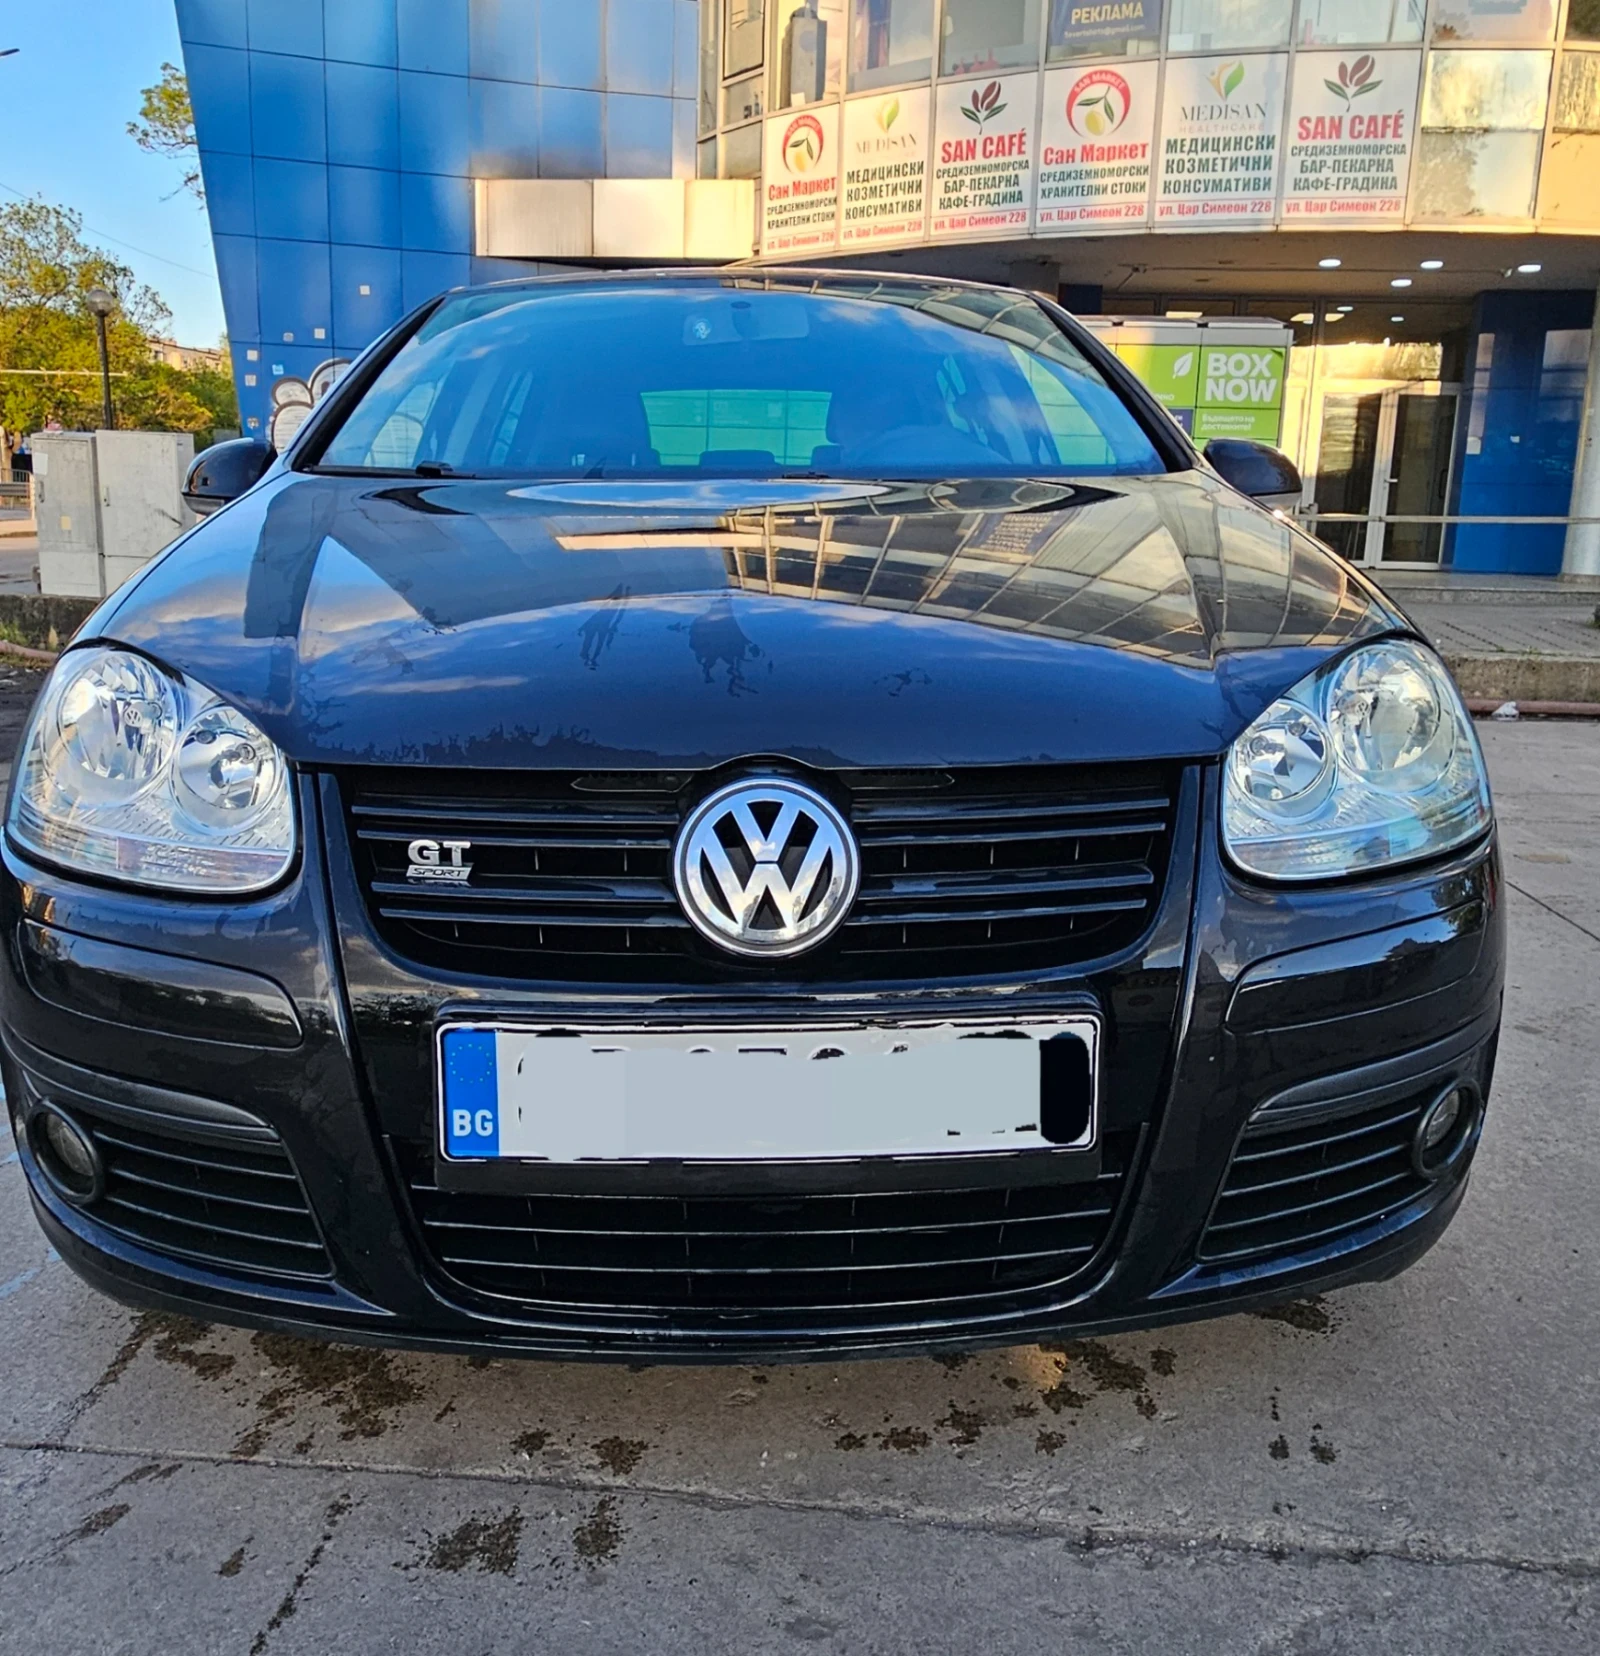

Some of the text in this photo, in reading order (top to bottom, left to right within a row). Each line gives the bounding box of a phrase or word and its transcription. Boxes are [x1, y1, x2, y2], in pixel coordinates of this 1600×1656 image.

[1071, 2, 1144, 25] РЕКЛАМА
[1181, 103, 1268, 120] MEDISAN
[1298, 109, 1404, 140] SAN CAFÉ
[942, 139, 977, 164] SAN
[982, 128, 1026, 159] CAFÉ
[1044, 143, 1148, 166] Сан Маркет
[1166, 135, 1276, 156] МЕДИЦИНСКИ
[1291, 144, 1406, 158] СРЕДИЗЕМНОМОРСКА
[846, 161, 924, 184] МЕДИЦИНСКИ
[936, 159, 1029, 179] СРЕДИЗЕМНОМОРСКА
[1040, 165, 1149, 183] СРЕДИЗЕМНОМОРСКИ
[1165, 155, 1272, 174] КОЗМЕТИЧНИ
[1300, 158, 1394, 174] БАР-ПЕКАРНА
[769, 177, 836, 201] Сан Маркет
[846, 179, 922, 202] КОЗМЕТИЧНИ
[944, 174, 1019, 194] БАР-ПЕКАРНА
[1041, 181, 1146, 199] ХРАНИТЕЛНИ СТОКИ
[1163, 177, 1272, 194] КОНСУМАТИВИ
[1293, 176, 1397, 192] КАФЕ-ГРАДИНА
[845, 199, 922, 220] КОНСУМАТИВИ
[939, 190, 1022, 210] КАФЕ-ГРАДИНА
[1178, 204, 1199, 215] Цар
[1202, 202, 1247, 213] Симеон
[1251, 201, 1271, 213] 228
[1305, 201, 1327, 212] Цар
[1330, 200, 1376, 212] Симеон
[1380, 200, 1400, 212] 228
[812, 212, 834, 223] СТОКИ
[969, 215, 1006, 226] Симеон
[1009, 211, 1026, 223] 228
[1057, 210, 1077, 221] Цар
[1080, 208, 1122, 219] Симеон
[1124, 205, 1144, 216] 228
[1207, 353, 1272, 377] BOX
[1205, 378, 1276, 402] NOW
[408, 839, 471, 866] GT
[412, 868, 464, 877] SPORT
[691, 789, 846, 943] VW
[453, 1110, 493, 1137] BG
